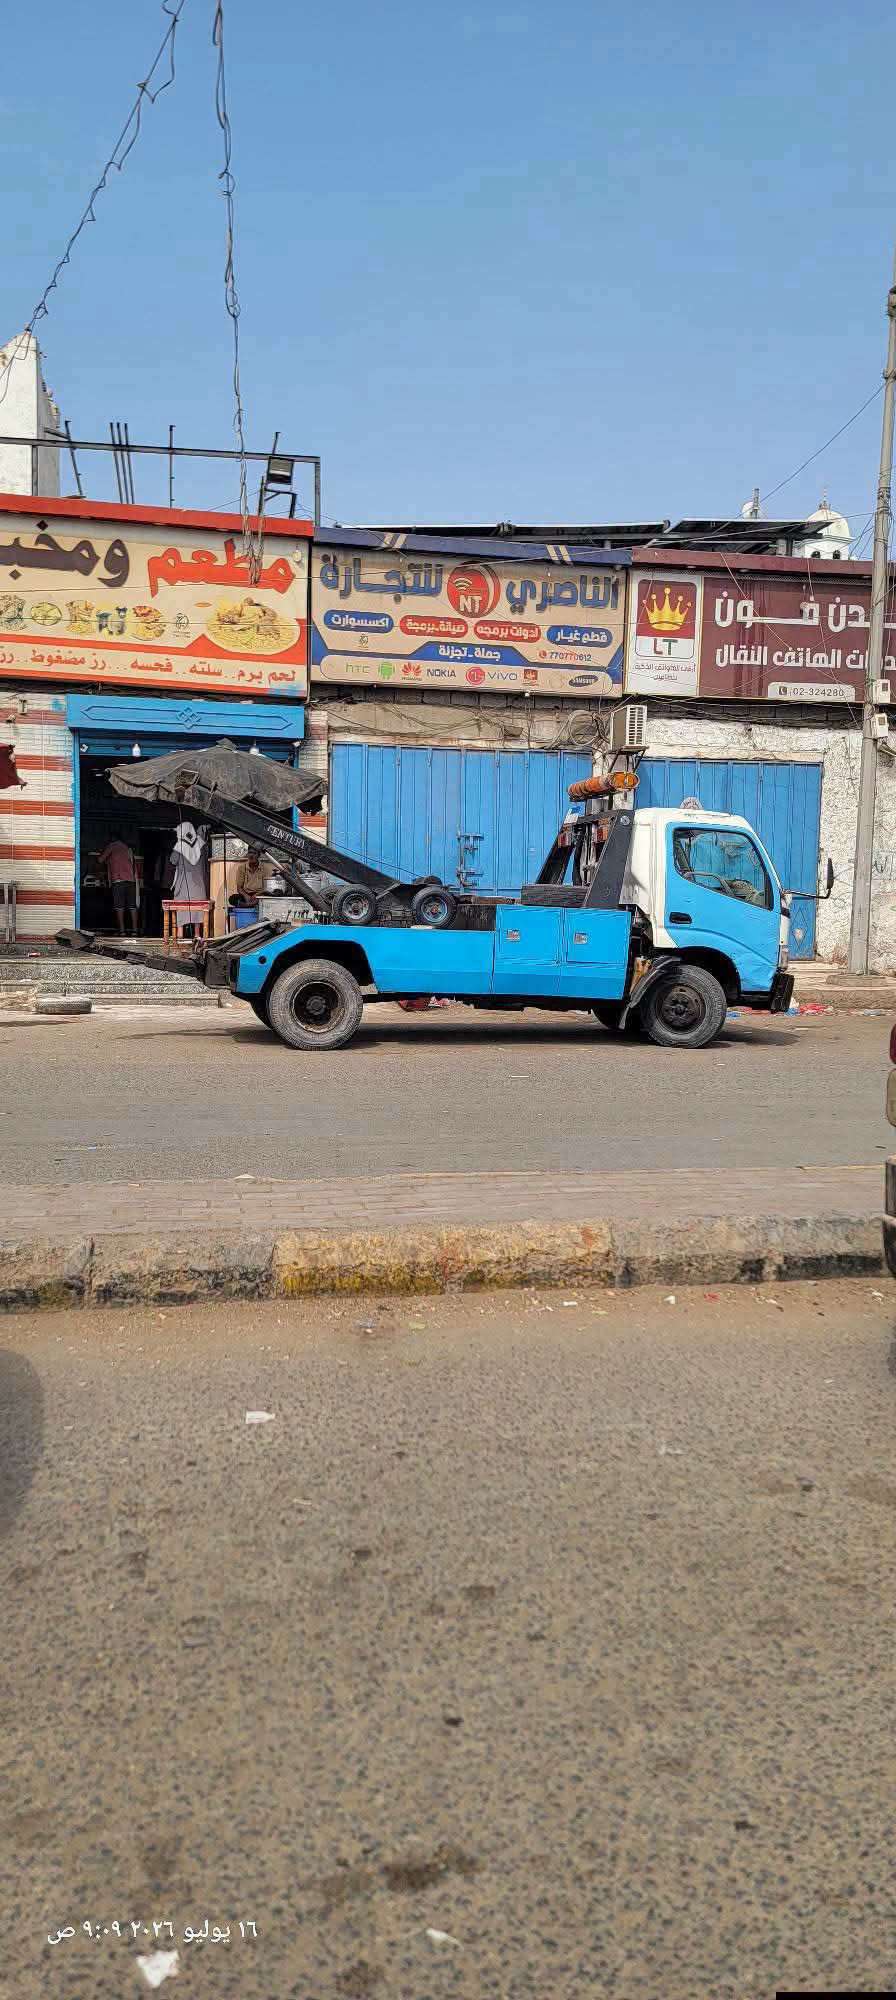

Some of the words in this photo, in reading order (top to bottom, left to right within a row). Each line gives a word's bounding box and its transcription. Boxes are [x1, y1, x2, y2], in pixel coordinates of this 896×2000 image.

[148, 538, 296, 598] مطعم
[320, 554, 443, 604] للتجارة
[460, 595, 482, 613] NT
[505, 575, 619, 616] الناصري
[555, 629, 581, 643] غيار
[581, 631, 608, 643] قطع
[654, 638, 678, 655] LT
[31, 649, 86, 667] مضغوط
[715, 644, 768, 668] النقال
[772, 646, 841, 669] الهاتف
[268, 670, 296, 684] لحم
[426, 668, 457, 678] NOKIA
